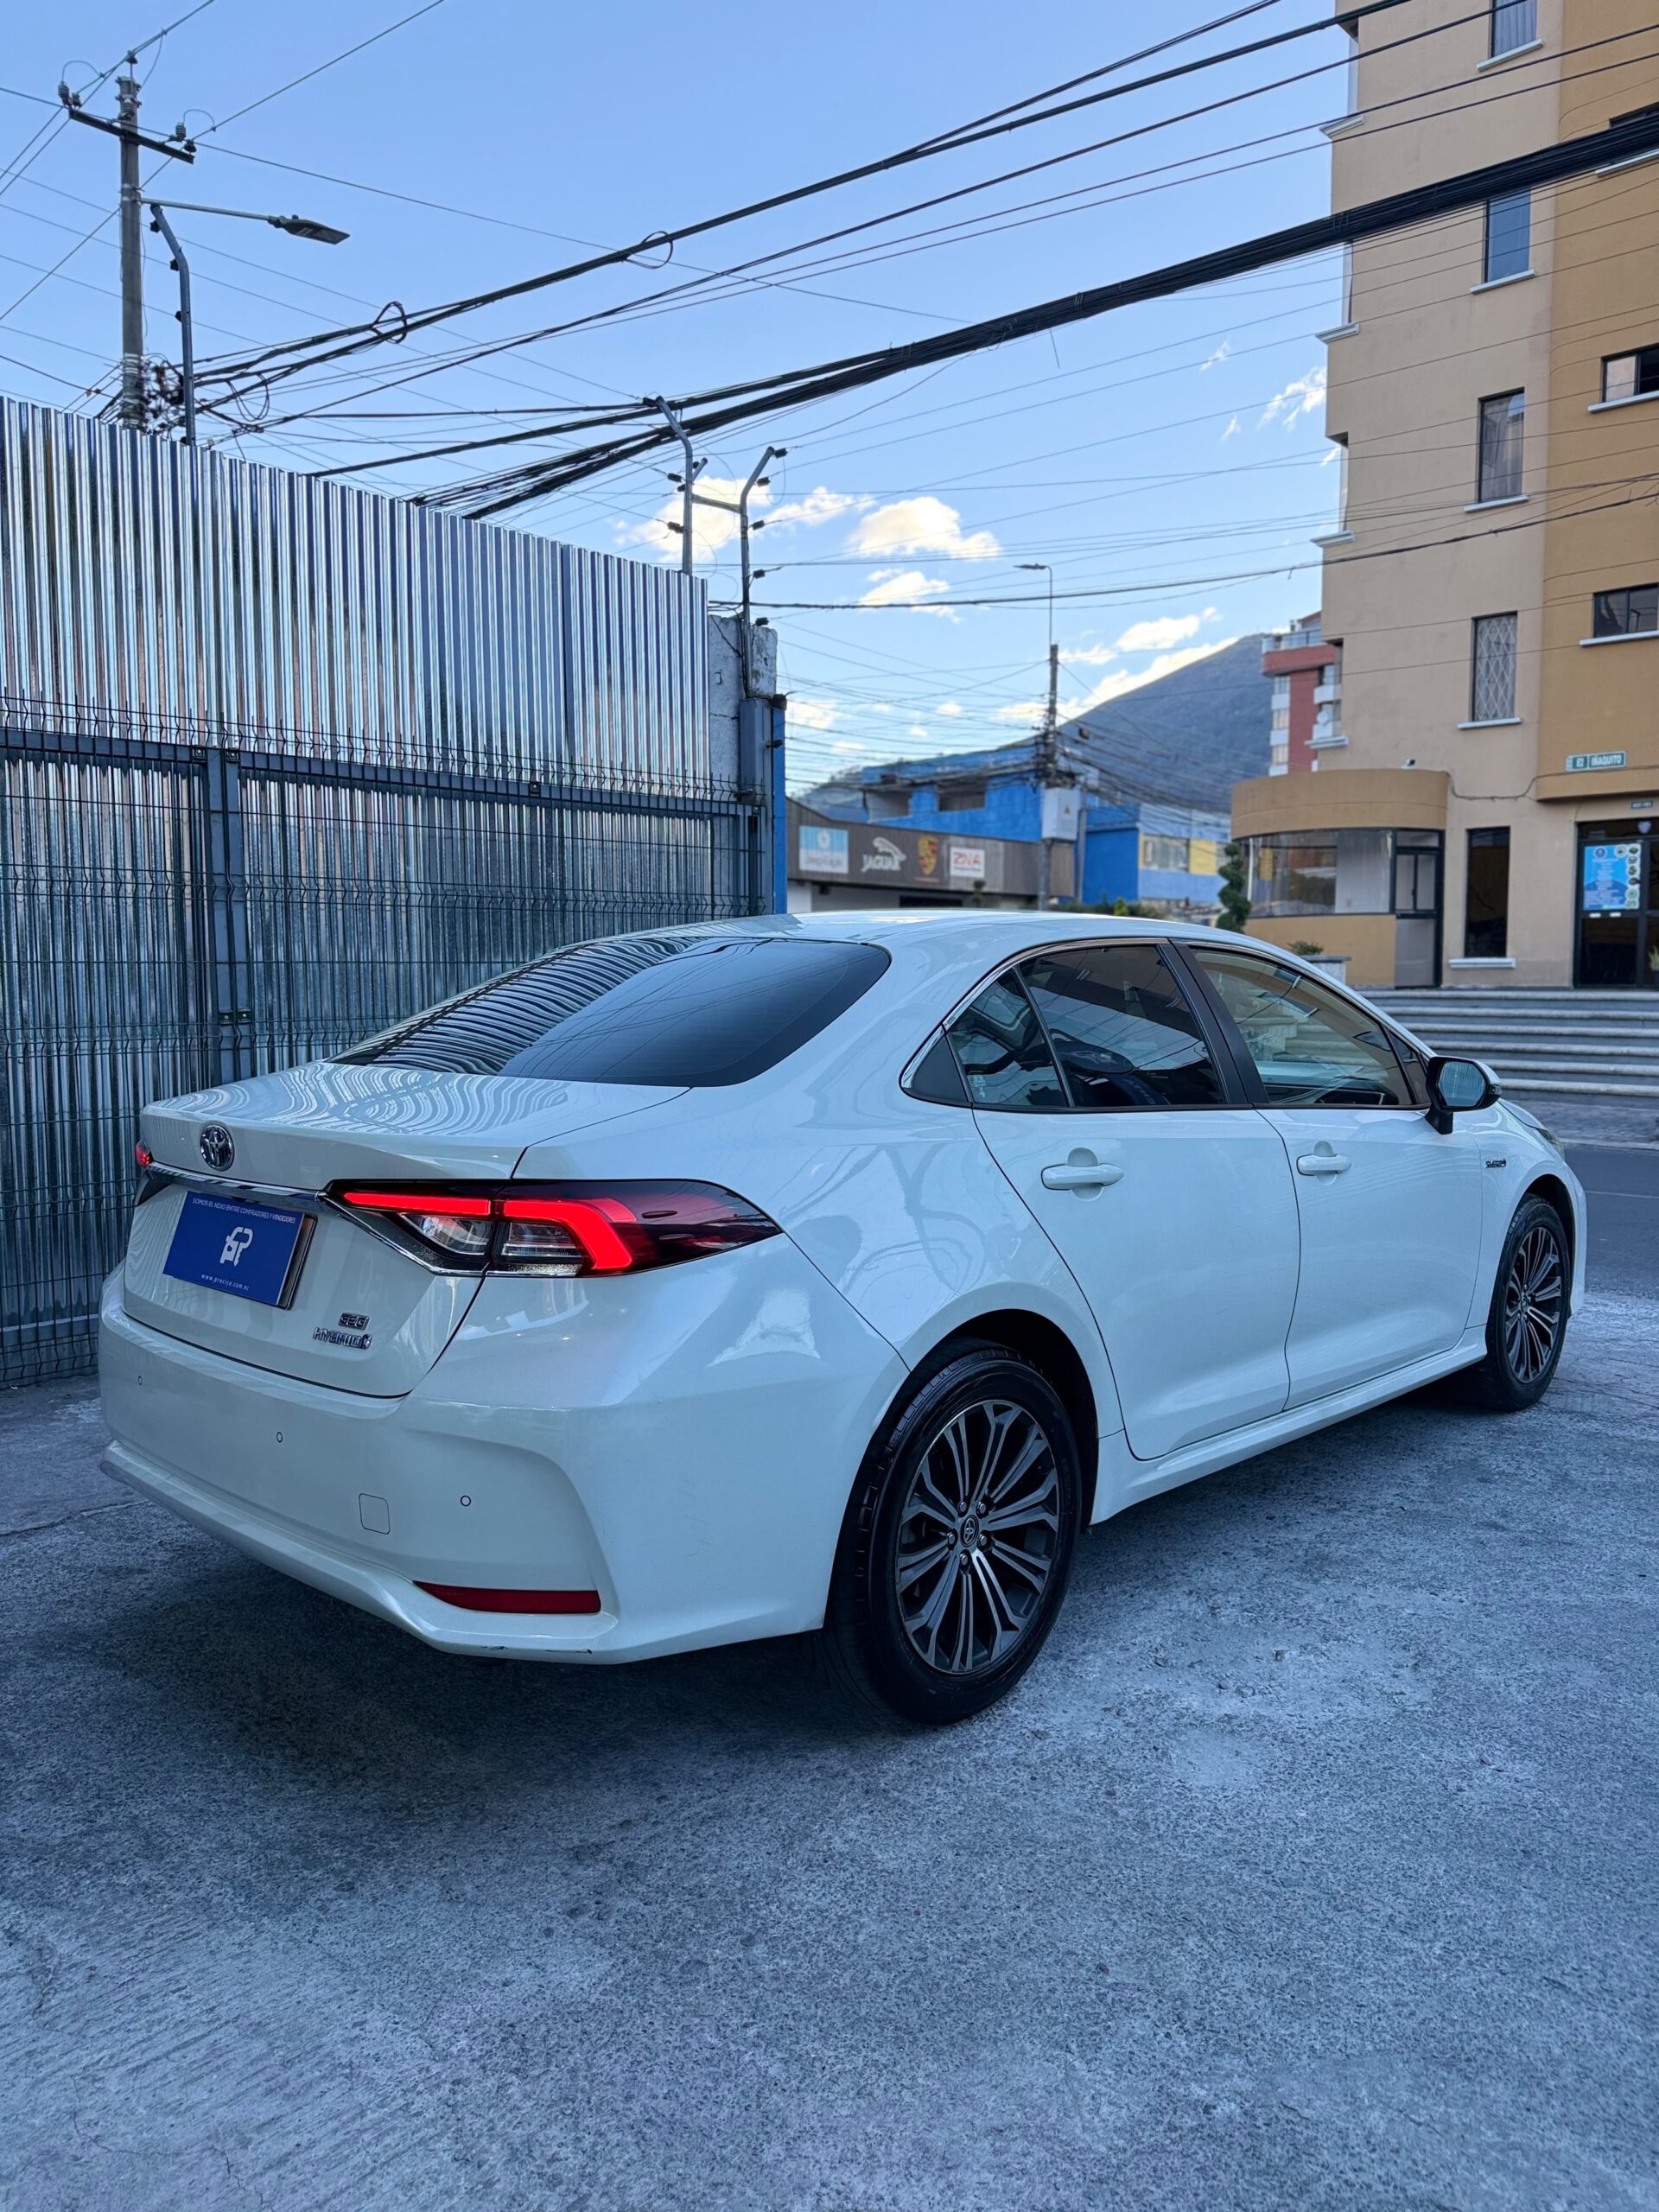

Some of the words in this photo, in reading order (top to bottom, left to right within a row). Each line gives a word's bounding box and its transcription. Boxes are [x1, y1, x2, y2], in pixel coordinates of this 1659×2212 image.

[193, 1197, 208, 1207] SOMOS
[226, 1204, 240, 1213] ENTRE
[240, 1207, 270, 1219] COMPRADORES
